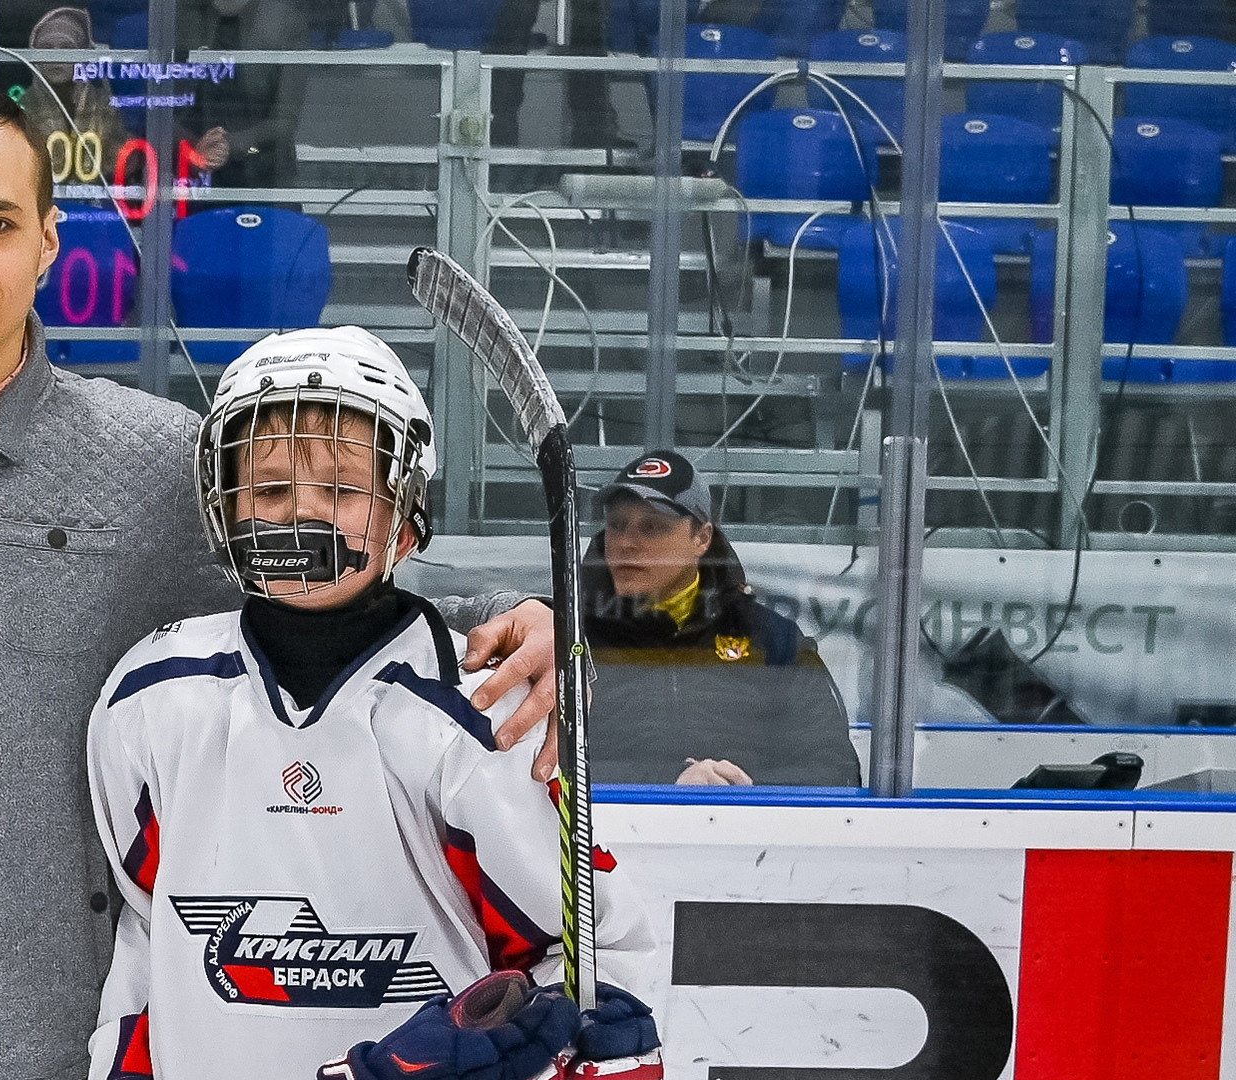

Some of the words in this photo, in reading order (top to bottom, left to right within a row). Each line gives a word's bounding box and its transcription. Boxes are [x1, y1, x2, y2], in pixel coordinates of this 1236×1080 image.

[250, 556, 309, 567] BAUER
[234, 937, 405, 961] КРИСТАЛЛ
[215, 968, 238, 998] ФОНД
[272, 967, 366, 990] БЕРДСК
